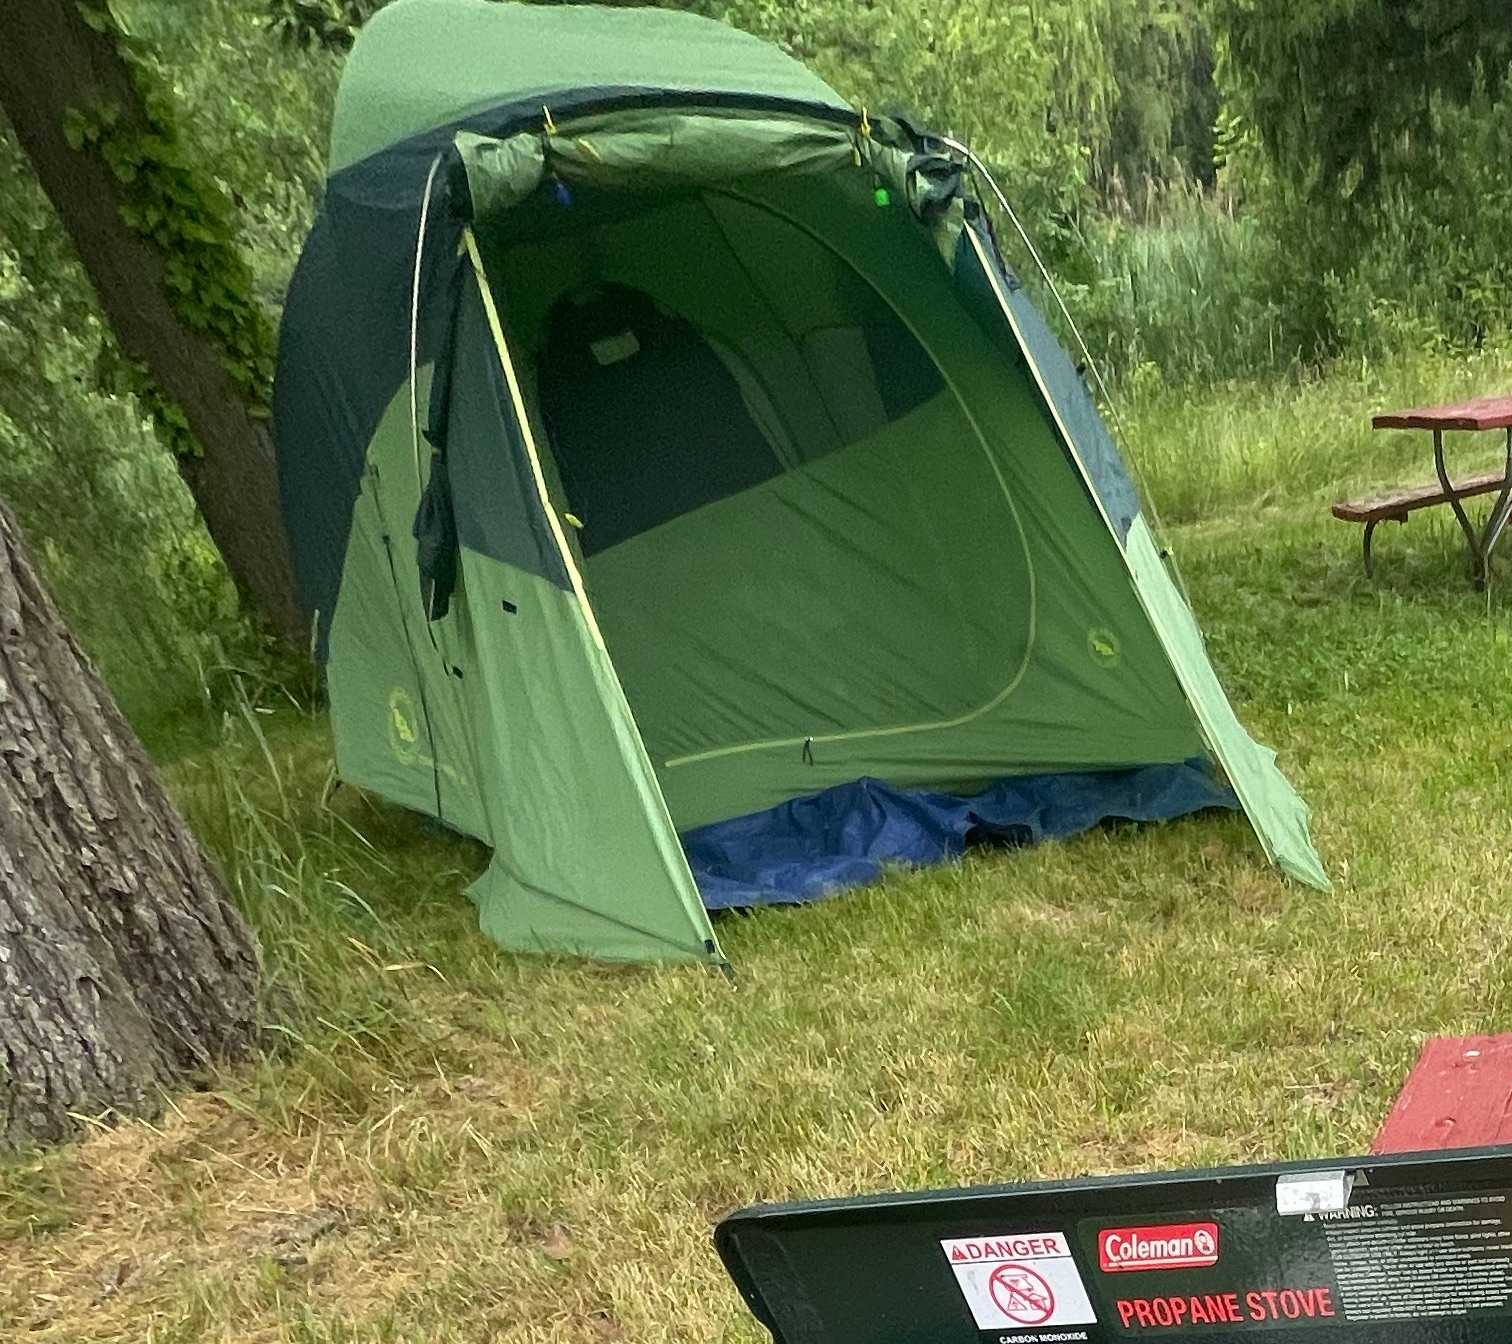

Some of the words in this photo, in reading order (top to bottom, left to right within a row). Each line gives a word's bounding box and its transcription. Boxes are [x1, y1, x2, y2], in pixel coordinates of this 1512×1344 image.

[966, 1238, 1060, 1259] DANGER
[1105, 1233, 1193, 1261] Coleman
[1117, 1292, 1244, 1328] PROPANE
[1247, 1288, 1335, 1321] STOVE
[1000, 1334, 1038, 1344] CARBON
